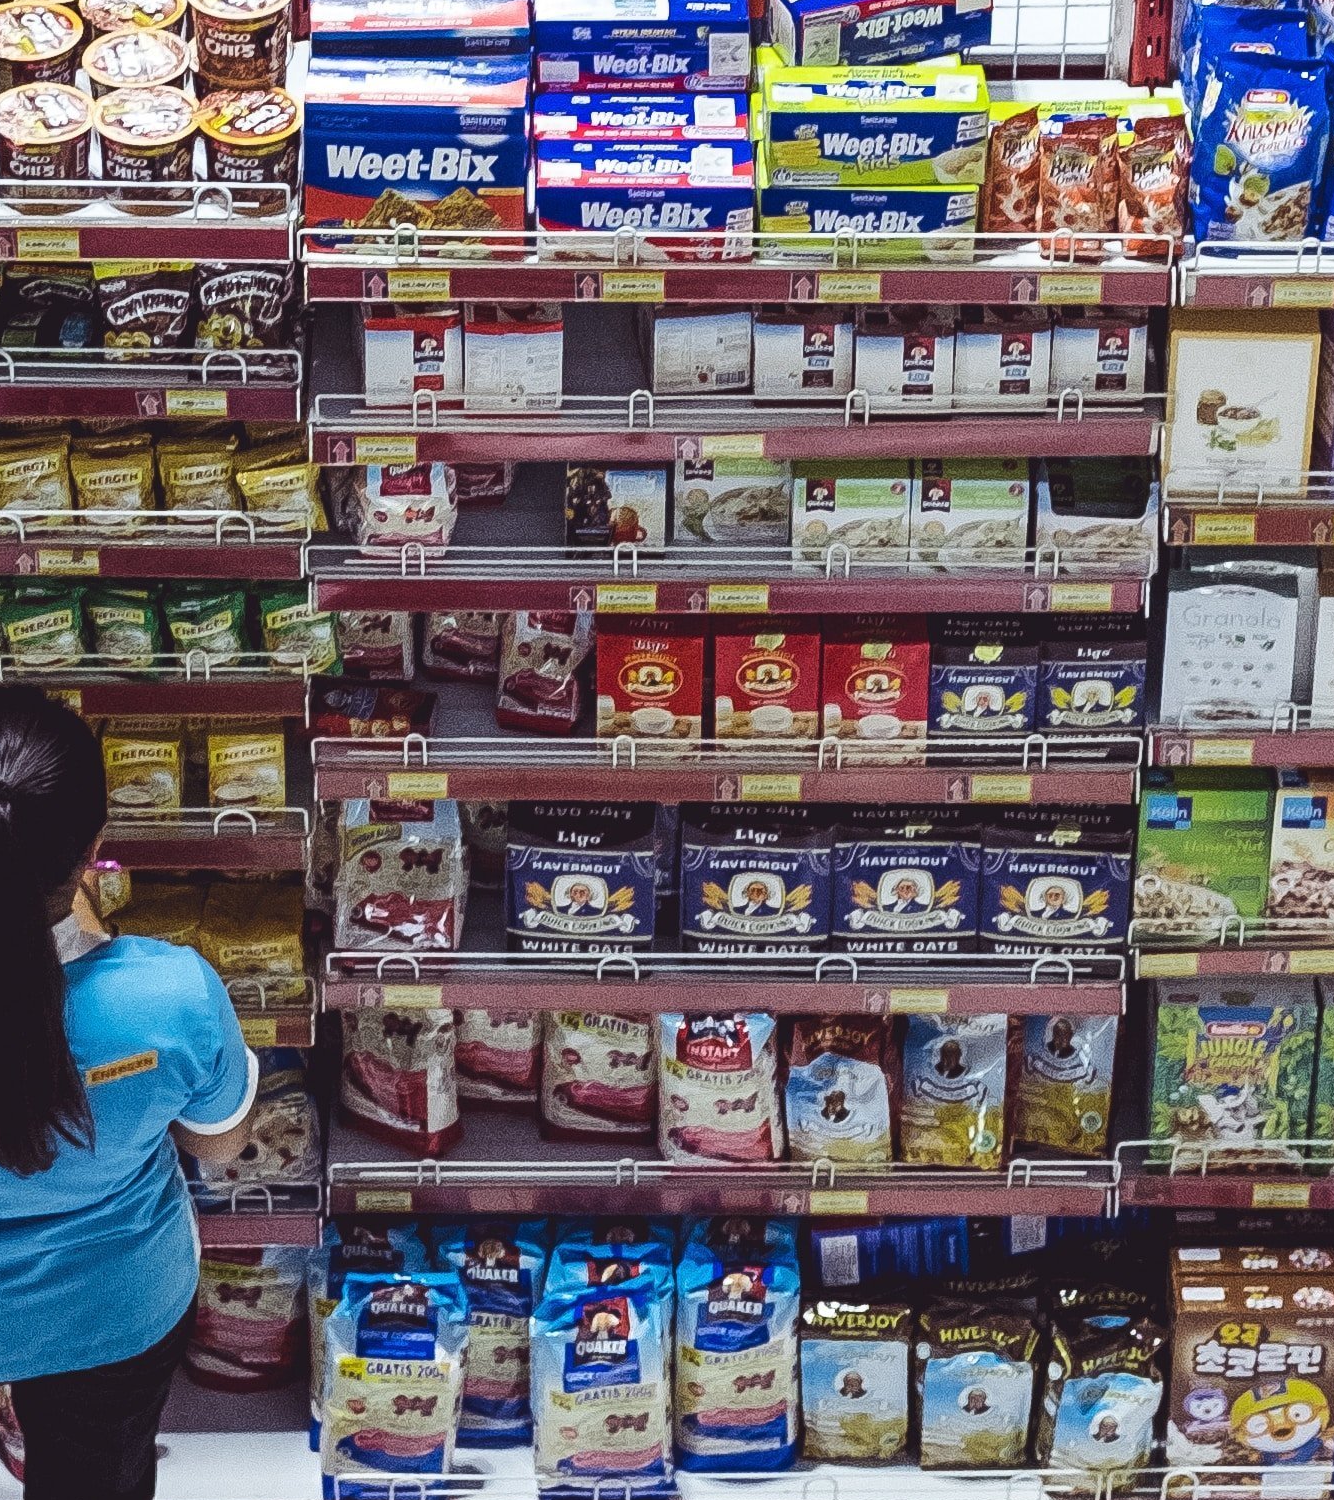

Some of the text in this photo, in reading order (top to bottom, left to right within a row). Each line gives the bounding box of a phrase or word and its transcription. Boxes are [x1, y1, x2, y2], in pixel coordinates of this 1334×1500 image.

[592, 53, 691, 75] Weet-Bix
[459, 115, 507, 128] Sanitarium
[1227, 116, 1310, 143] Knusper
[326, 144, 498, 182] Weet-Bix
[1049, 158, 1096, 178] Berry
[580, 201, 713, 229] Weet-Bix
[10, 615, 71, 638] ENERGEN
[1181, 606, 1283, 632] Granola
[1075, 647, 1111, 661] Ligo
[106, 748, 173, 762] ENERGEN
[213, 747, 279, 760] ENERGEN
[556, 829, 603, 848] Ligo
[733, 827, 780, 845] Ligo
[531, 858, 624, 876] HAVERMOUT
[708, 858, 800, 874] HAVERMOUT
[858, 855, 950, 872] HAVERMOUT
[1008, 860, 1098, 876] HAVERMOUT
[521, 940, 634, 954] WHITE OATS
[697, 940, 810, 954] WHITE OATS
[845, 939, 959, 953] WHITE OATS
[1198, 1039, 1268, 1060] JUNGLE
[89, 1057, 156, 1082] ENERGEN
[369, 1301, 427, 1316] QUAKER
[707, 1300, 764, 1316] QUAKER
[575, 1340, 629, 1358] QUAKER
